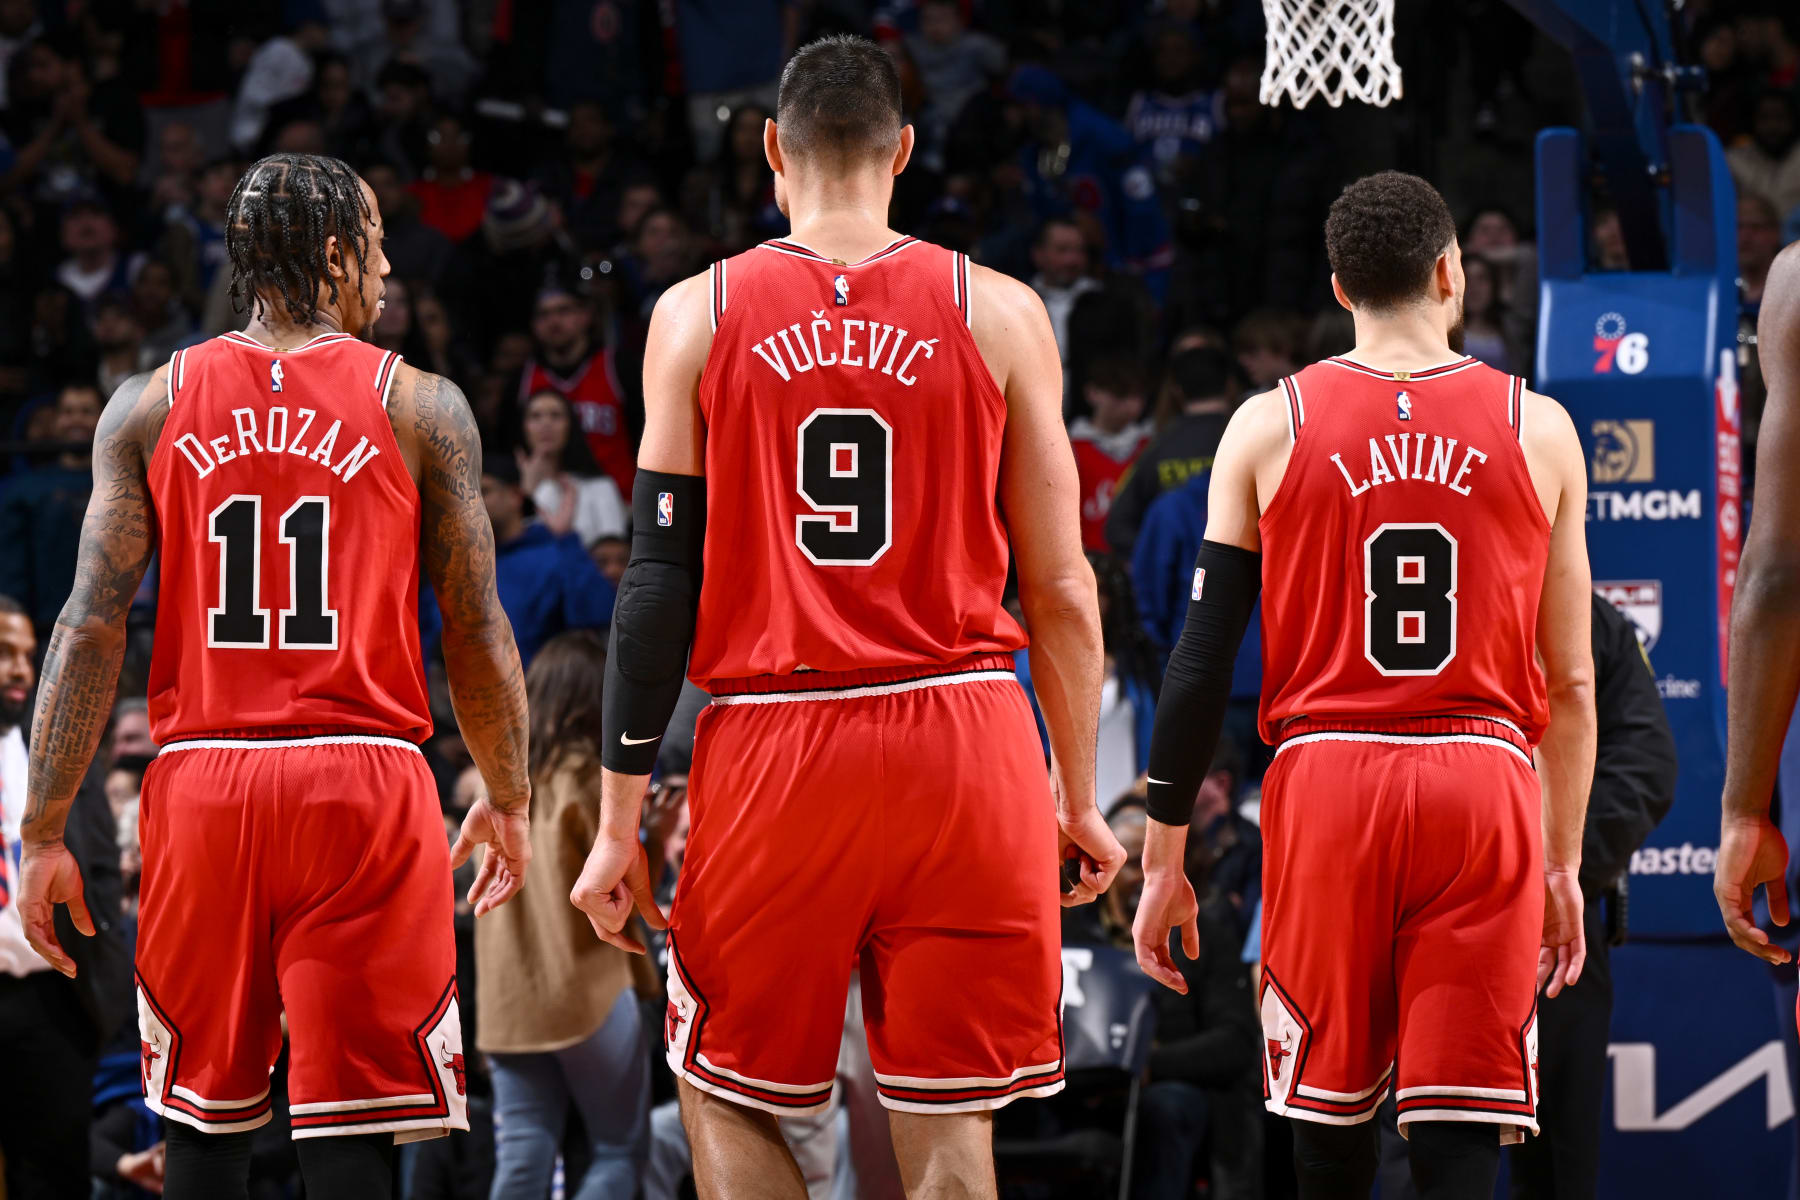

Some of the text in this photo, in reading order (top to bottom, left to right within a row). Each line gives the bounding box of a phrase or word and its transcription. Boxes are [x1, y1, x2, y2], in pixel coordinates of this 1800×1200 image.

[751, 309, 940, 387] VUČEVIĆ
[1593, 332, 1649, 375] 76
[173, 406, 380, 484] DeROZAN
[428, 427, 462, 464] WHY
[1329, 432, 1488, 498] LAVINE
[796, 407, 893, 567] 9
[207, 494, 339, 650] 11
[1363, 522, 1458, 677] 8
